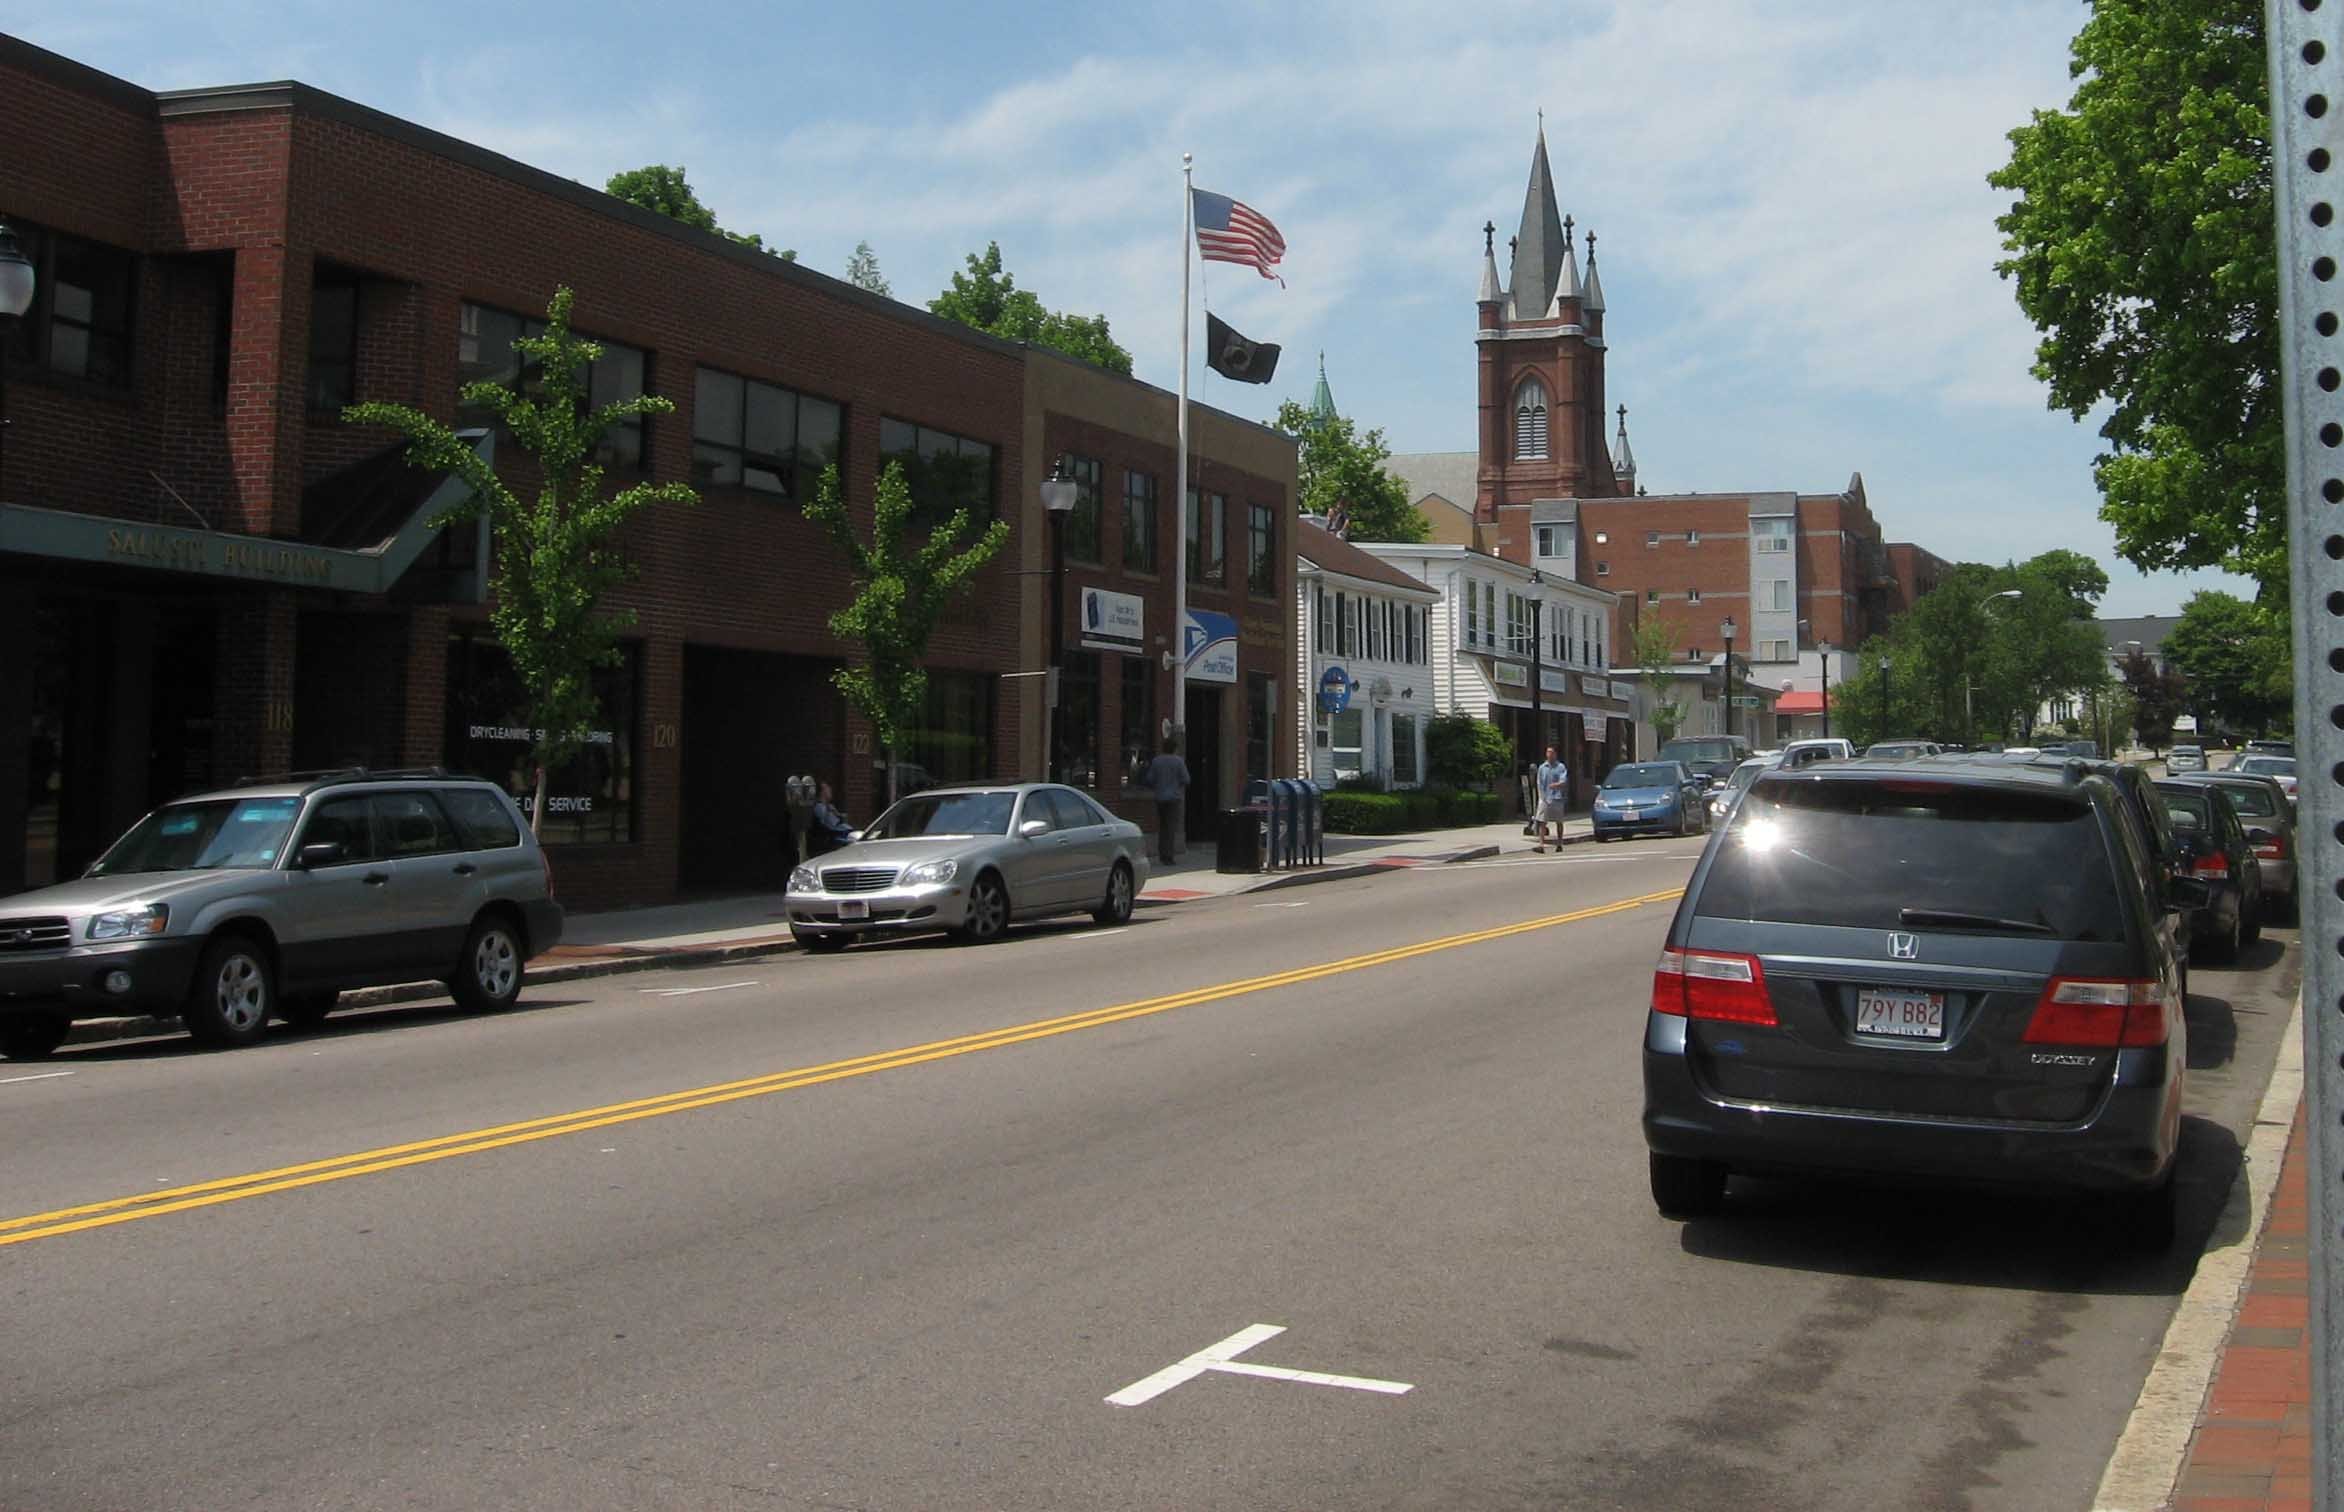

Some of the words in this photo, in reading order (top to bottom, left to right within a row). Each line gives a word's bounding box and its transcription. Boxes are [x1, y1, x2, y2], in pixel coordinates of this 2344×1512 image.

[224, 541, 331, 578] BUILDING
[267, 703, 294, 730] 118
[470, 725, 530, 742] DRYCLEANING
[654, 724, 675, 748] 120
[548, 796, 592, 812] SERVICE
[1860, 999, 1896, 1022] 79Y
[1903, 1000, 1941, 1025] B82
[2031, 1053, 2096, 1067] ODYSSEY
